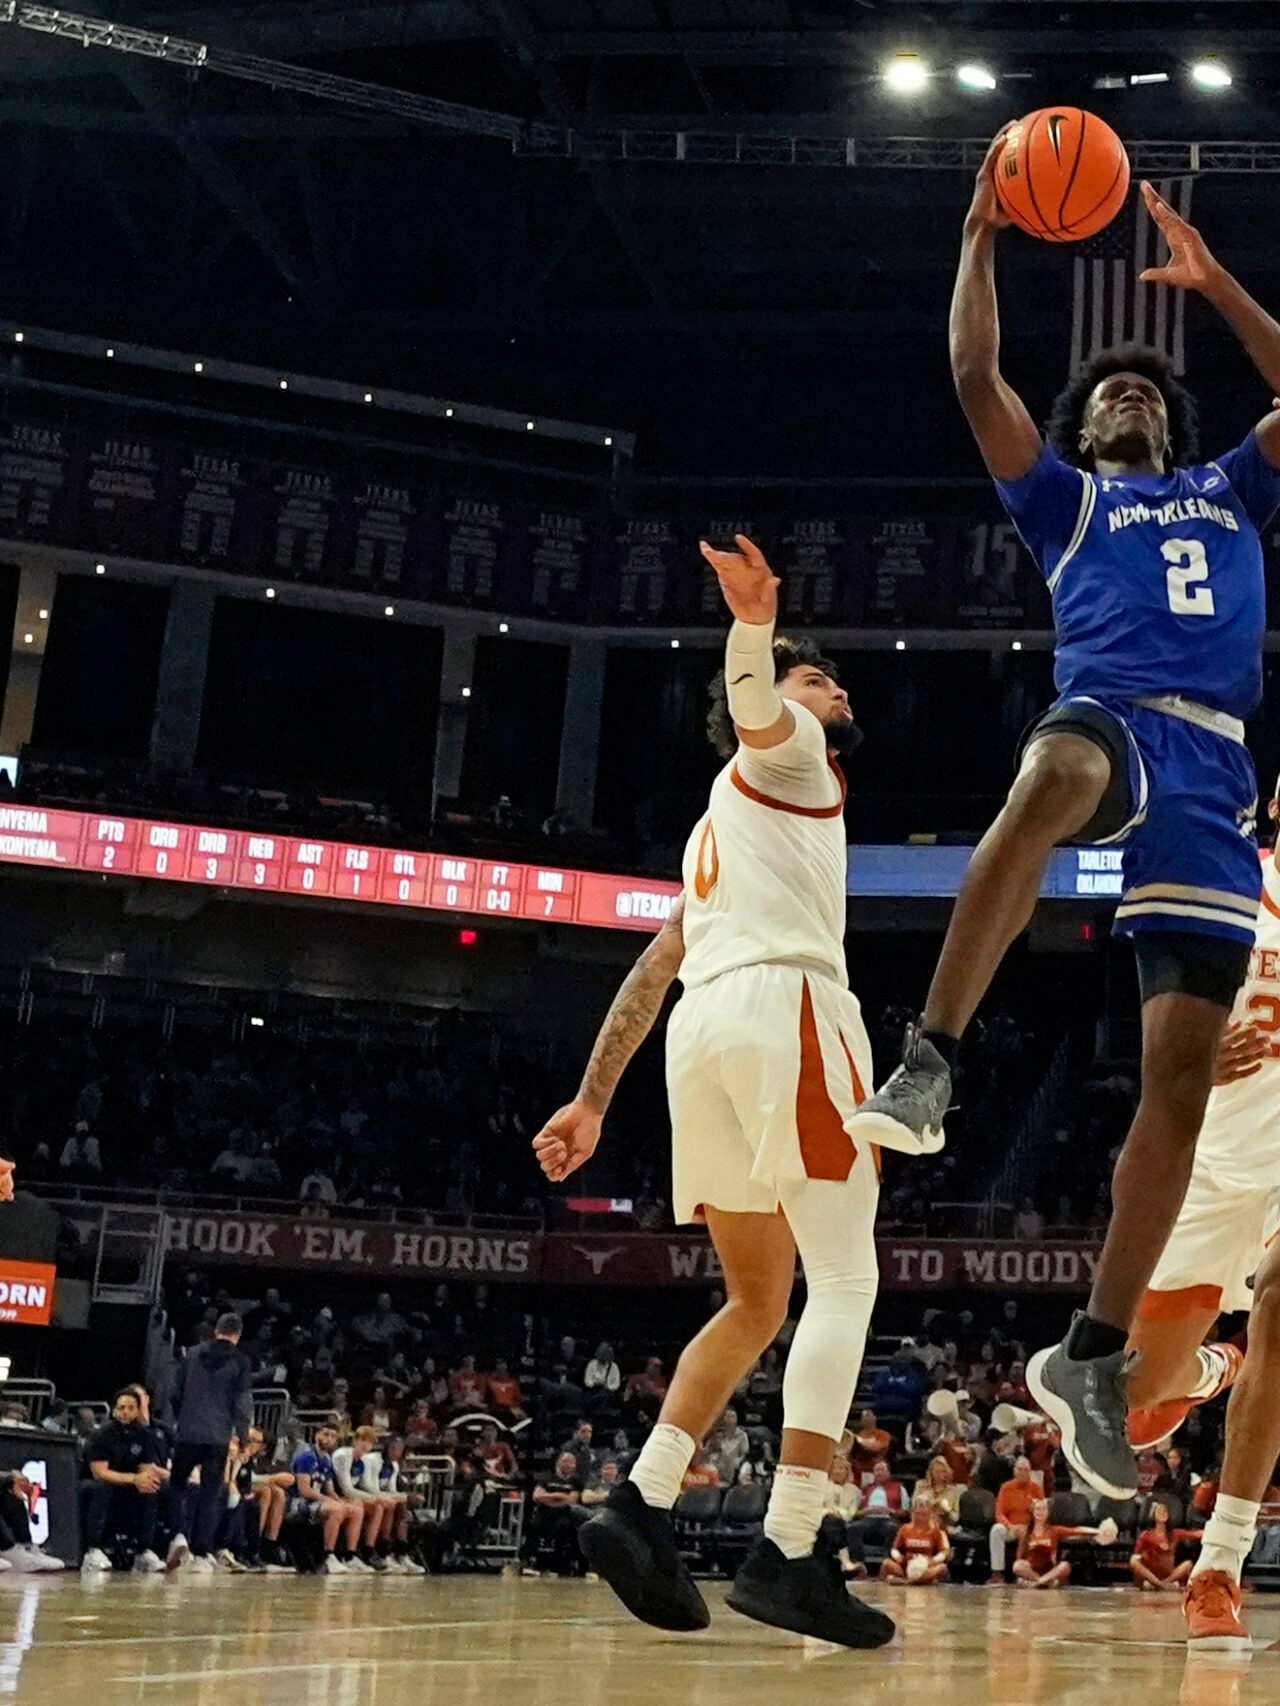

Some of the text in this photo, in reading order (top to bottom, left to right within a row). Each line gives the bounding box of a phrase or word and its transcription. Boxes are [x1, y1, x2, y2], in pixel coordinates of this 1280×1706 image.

[1108, 502, 1151, 533] NEW
[1160, 537, 1215, 616] 2
[98, 820, 125, 843] PTS
[150, 826, 179, 849] ORB
[248, 837, 275, 860] REB
[297, 842, 324, 865] AST
[345, 847, 370, 871] FLS
[393, 853, 416, 876] STL
[441, 858, 468, 882] BLK
[492, 864, 509, 887] FT
[536, 870, 564, 893] MIN
[102, 845, 555, 917] 2 0 3 3 0 1 0 0 0-0 7
[164, 1217, 279, 1259] HOOK
[391, 1232, 531, 1274] HORNS
[892, 1249, 944, 1283] TO
[963, 1249, 1100, 1285] MOODY
